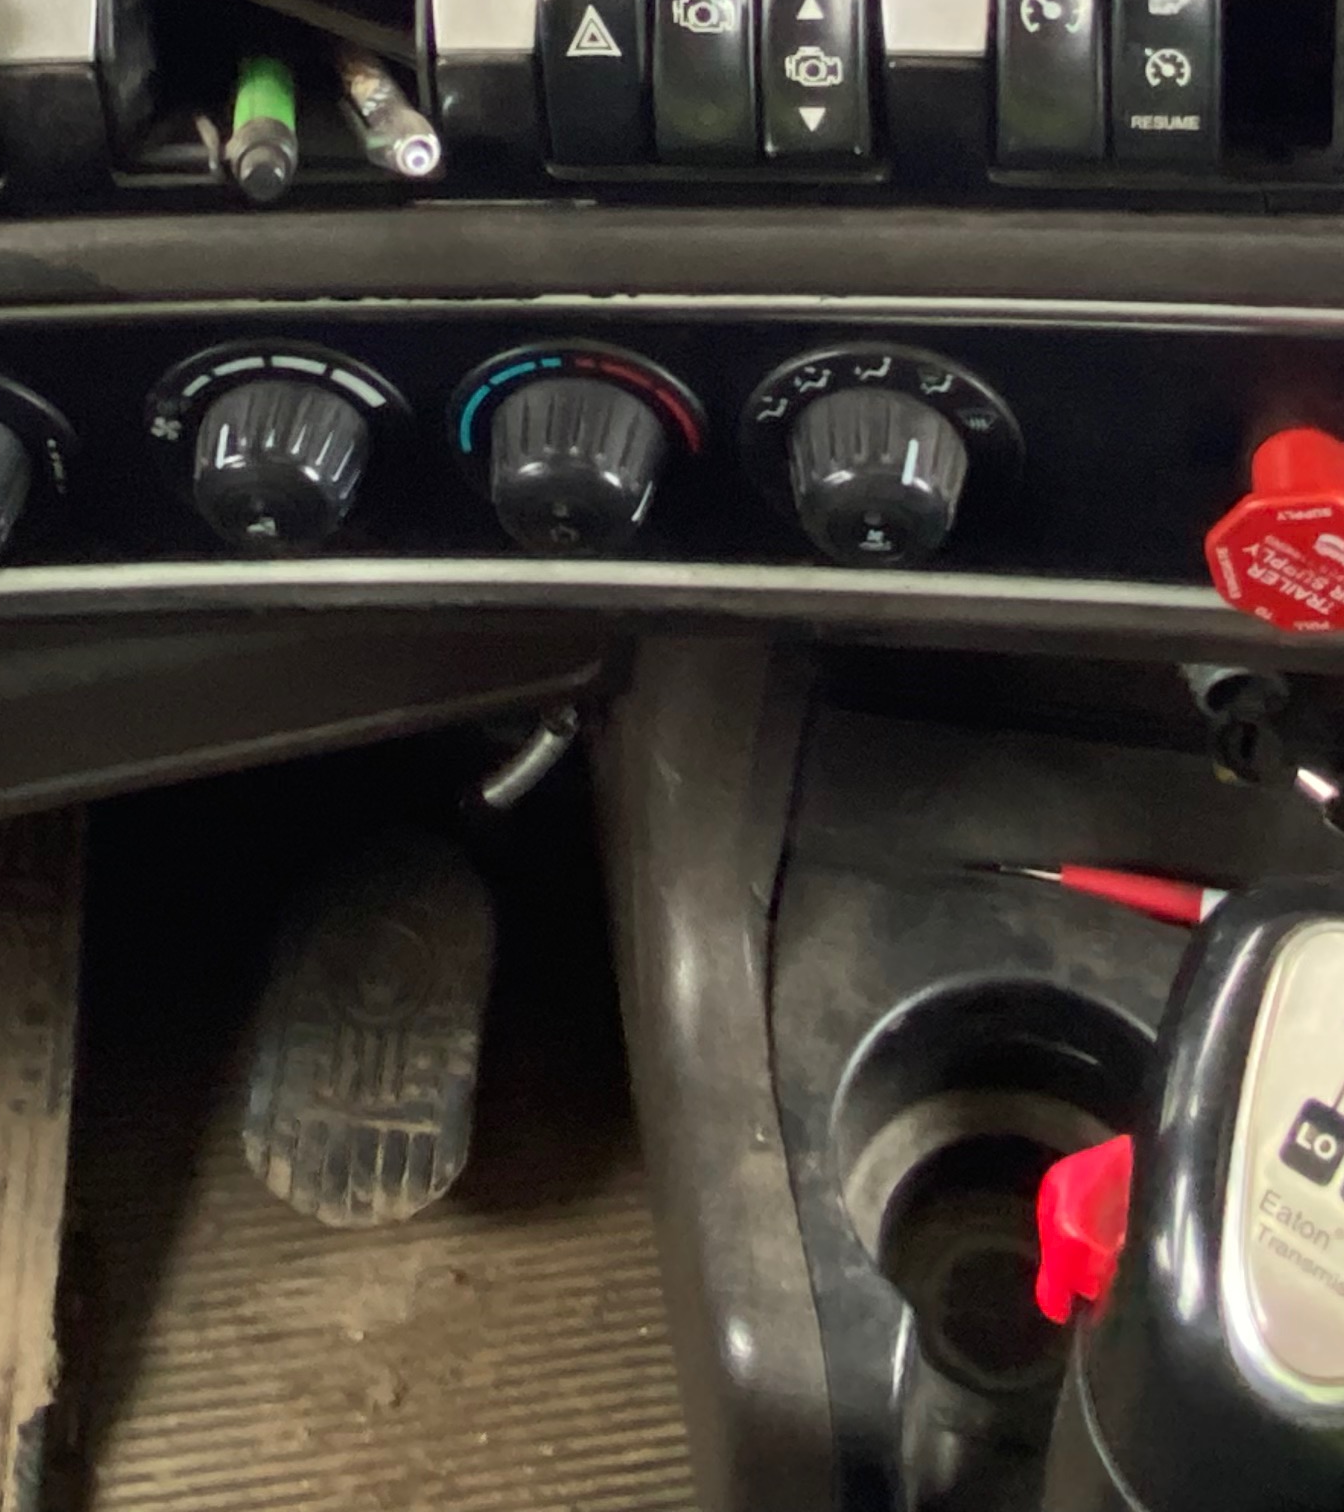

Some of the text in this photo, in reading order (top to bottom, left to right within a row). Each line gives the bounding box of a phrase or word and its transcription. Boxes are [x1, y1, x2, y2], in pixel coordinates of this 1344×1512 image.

[1130, 114, 1201, 131] RESUME
[1246, 562, 1335, 616] TRAILER
[1294, 1121, 1338, 1160] LO
